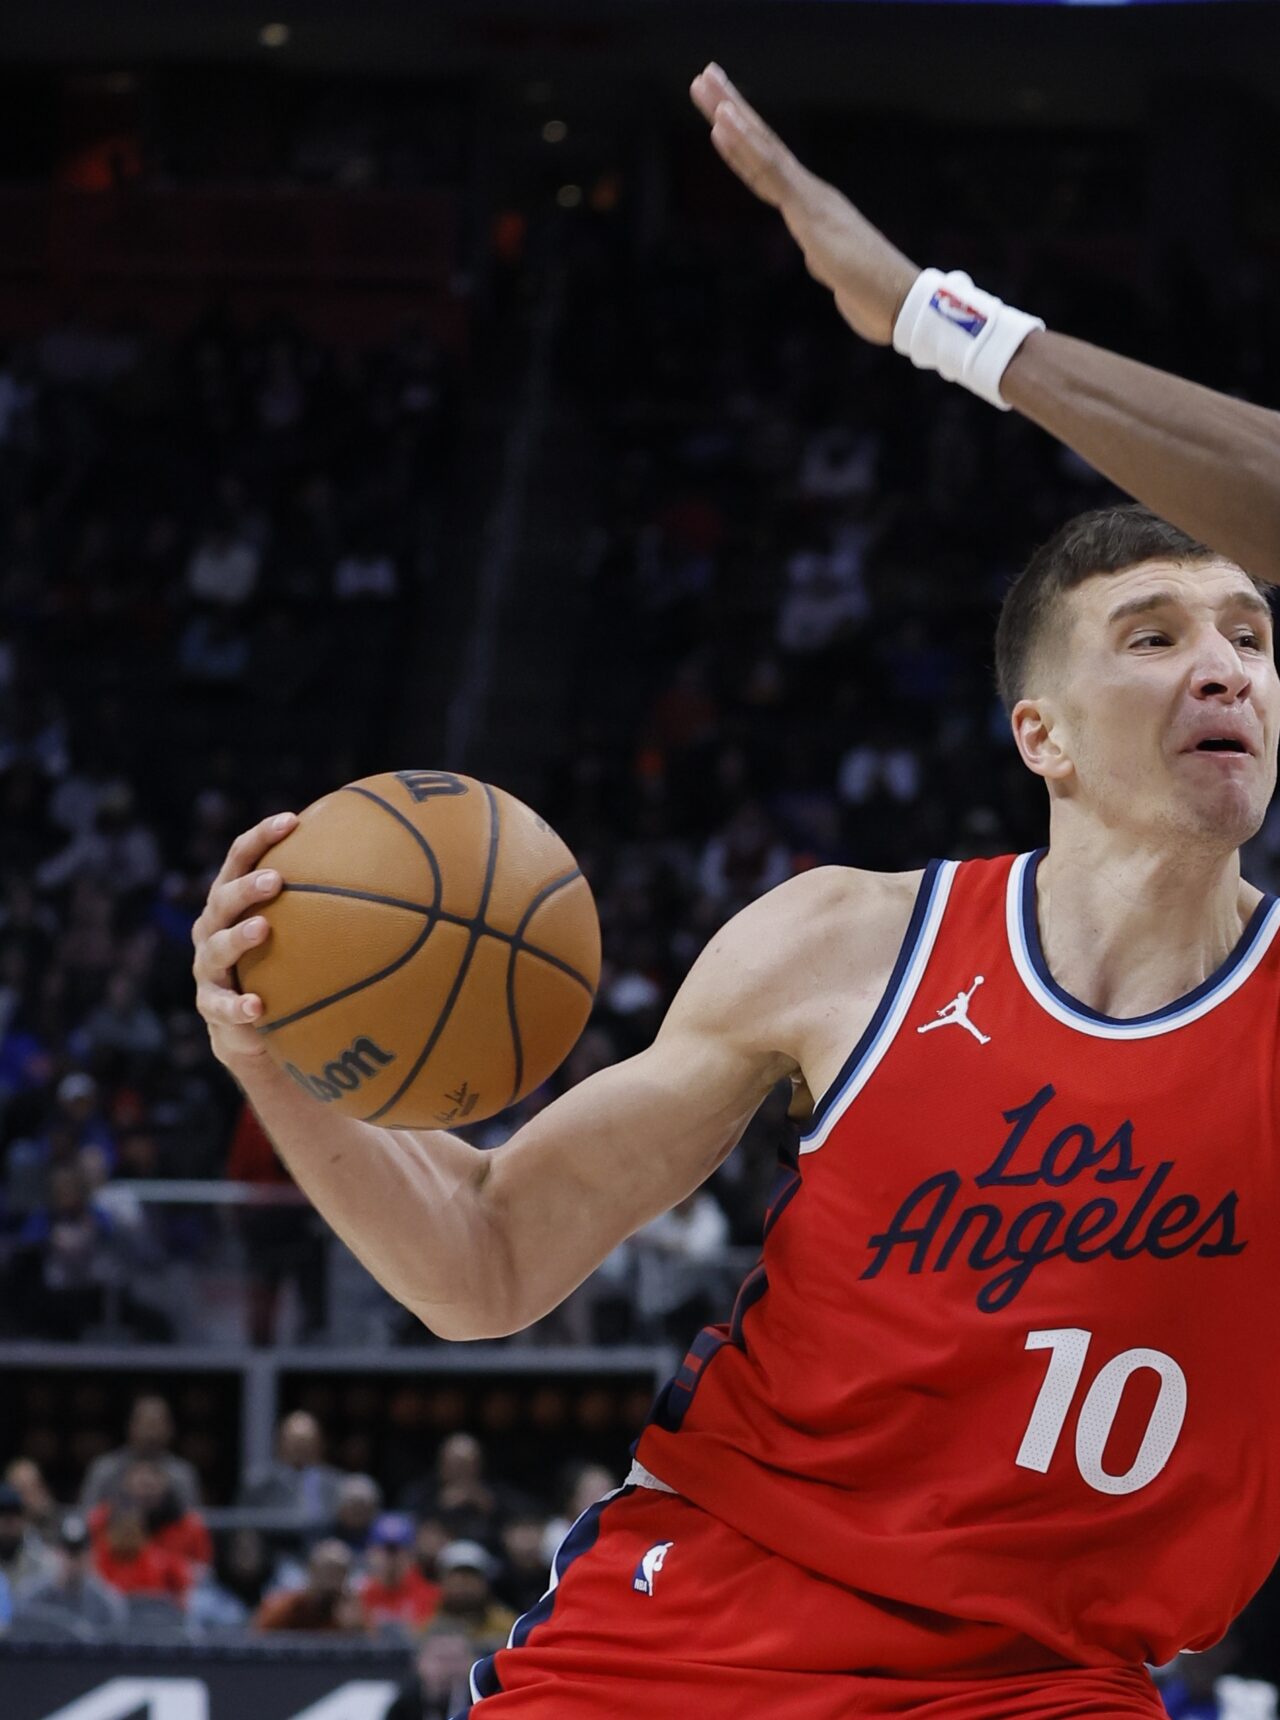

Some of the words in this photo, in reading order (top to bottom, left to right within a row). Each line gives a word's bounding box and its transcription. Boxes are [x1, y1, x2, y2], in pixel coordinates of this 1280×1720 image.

[974, 1083, 1144, 1189] Los
[858, 1161, 1248, 1313] Angeles
[1014, 1326, 1188, 1497] 10
